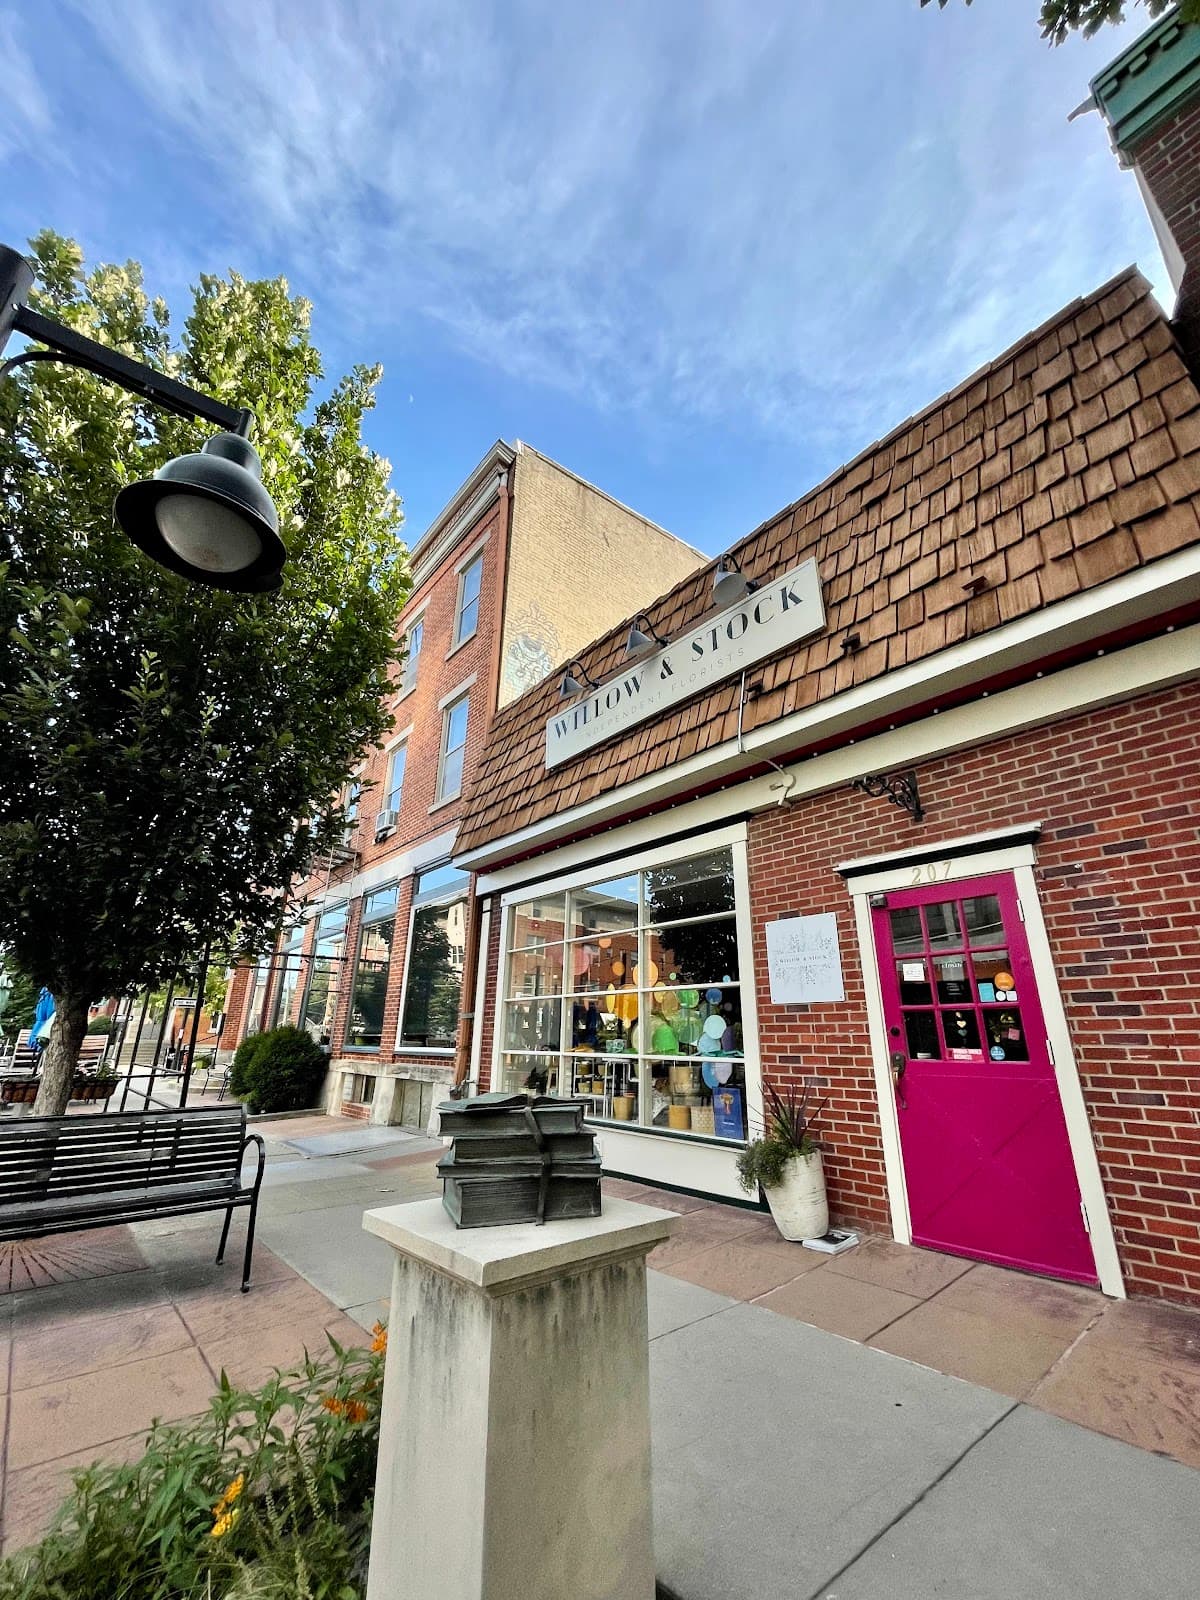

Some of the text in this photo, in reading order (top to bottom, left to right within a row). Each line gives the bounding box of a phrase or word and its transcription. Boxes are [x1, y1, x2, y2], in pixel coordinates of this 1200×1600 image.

[554, 579, 804, 739] WILLOW & STOCK
[582, 647, 745, 738] NDEPENDENT FLORISTS
[911, 860, 952, 885] 207
